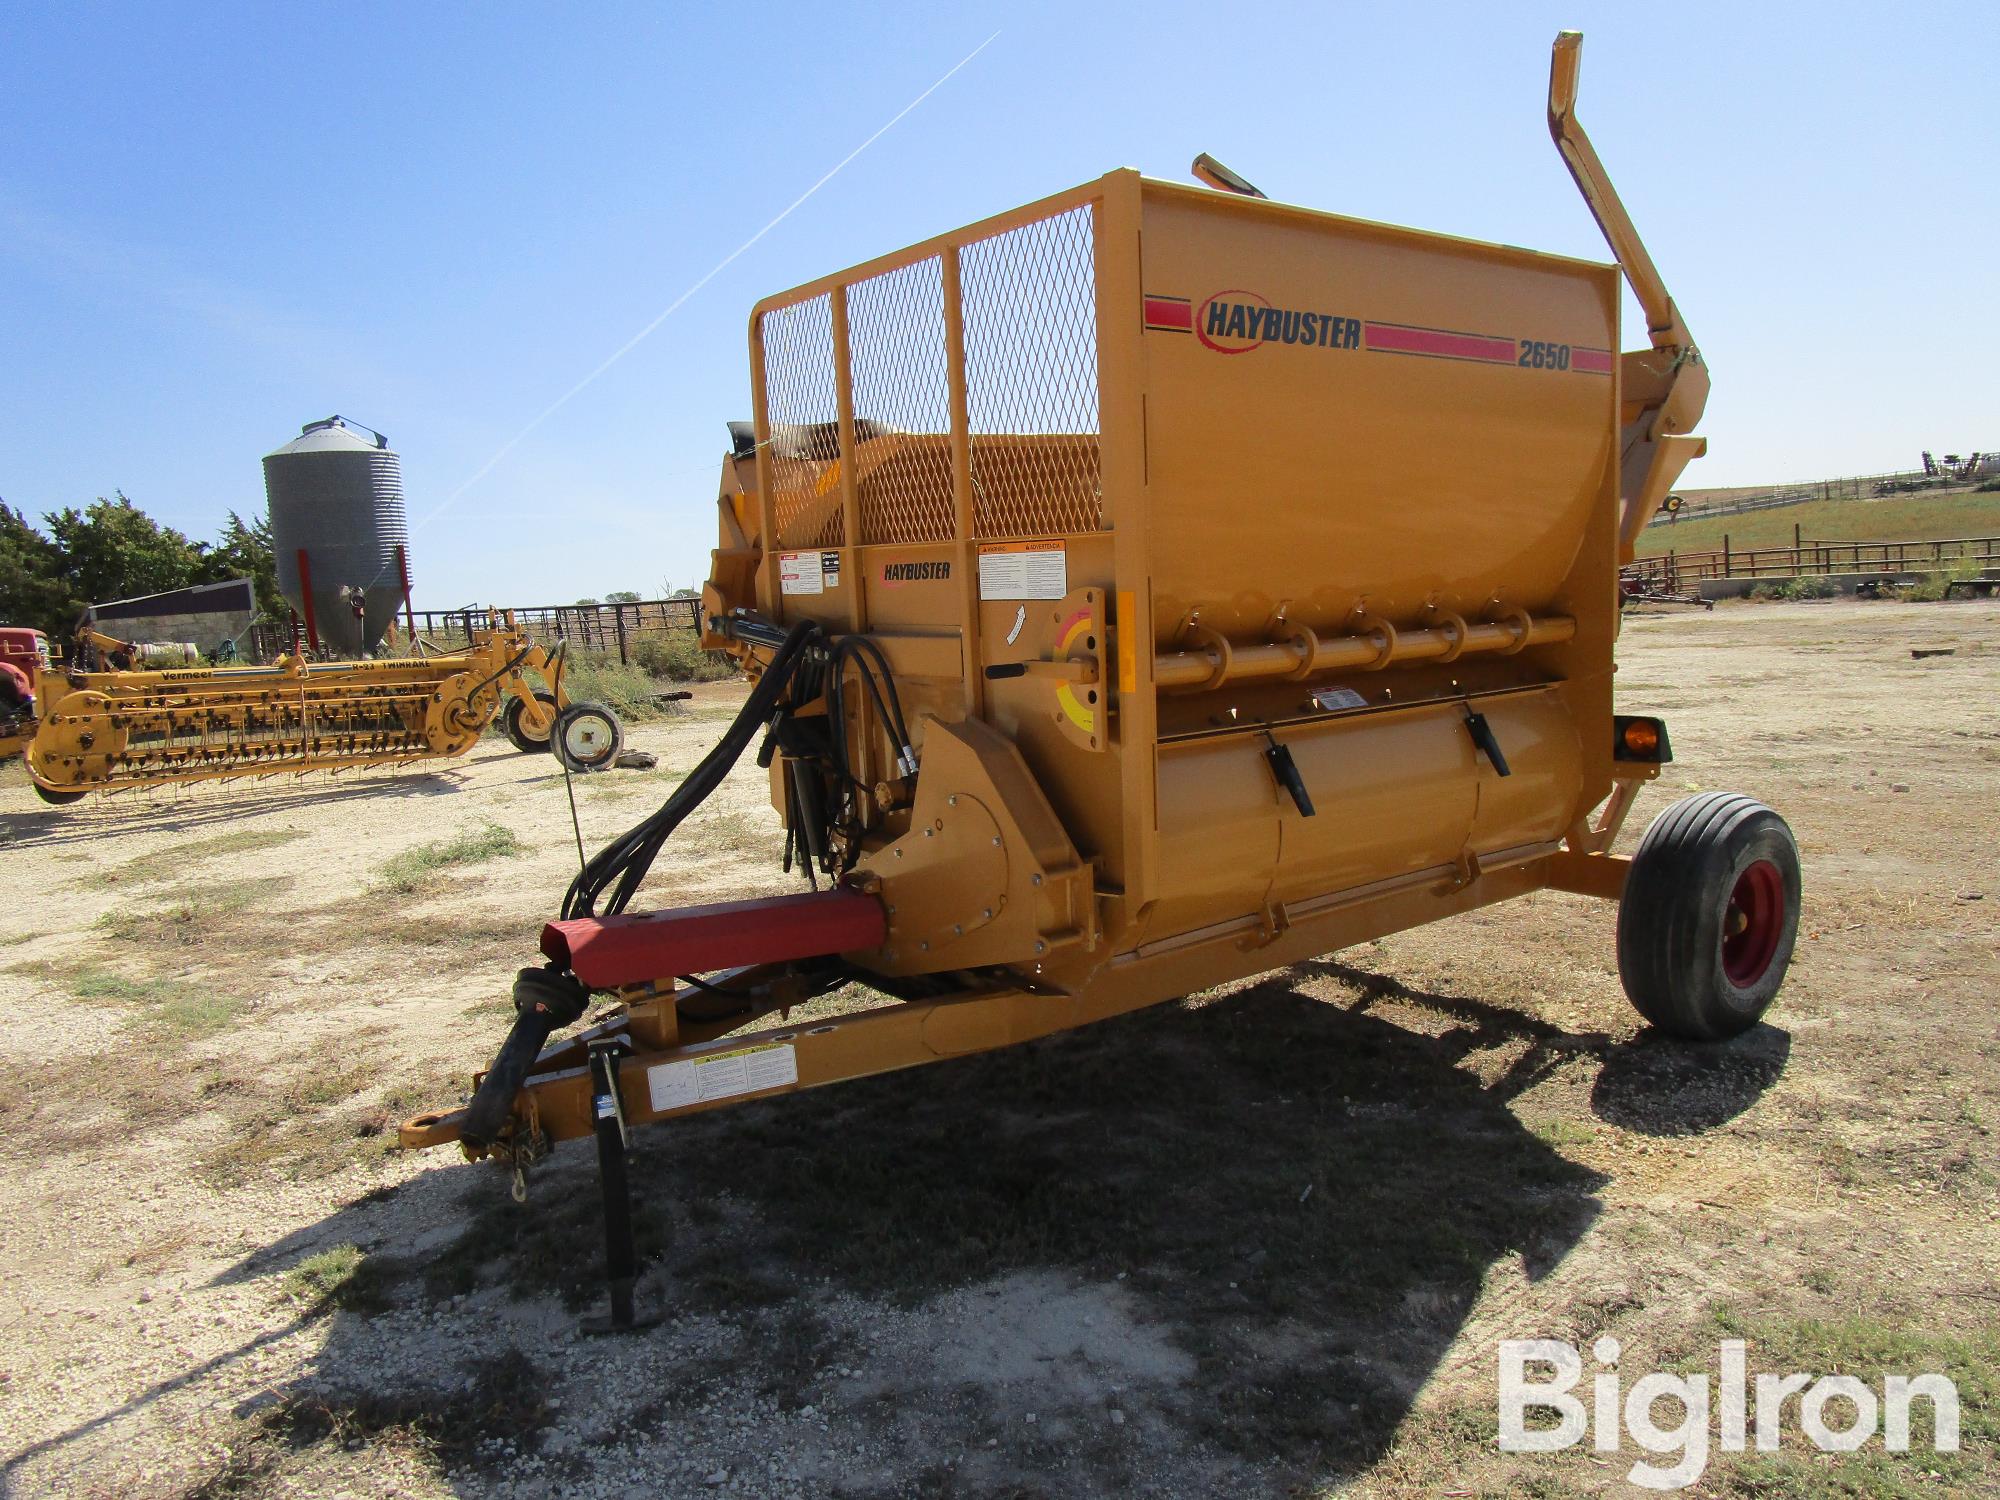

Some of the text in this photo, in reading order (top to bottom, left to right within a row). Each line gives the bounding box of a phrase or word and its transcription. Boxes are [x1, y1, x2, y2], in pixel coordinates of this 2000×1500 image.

[1207, 302, 1361, 350] HAYBUSTER
[1519, 339, 1570, 371] 2650
[884, 561, 951, 581] HAYBUSTER
[161, 671, 212, 681] Vermeer
